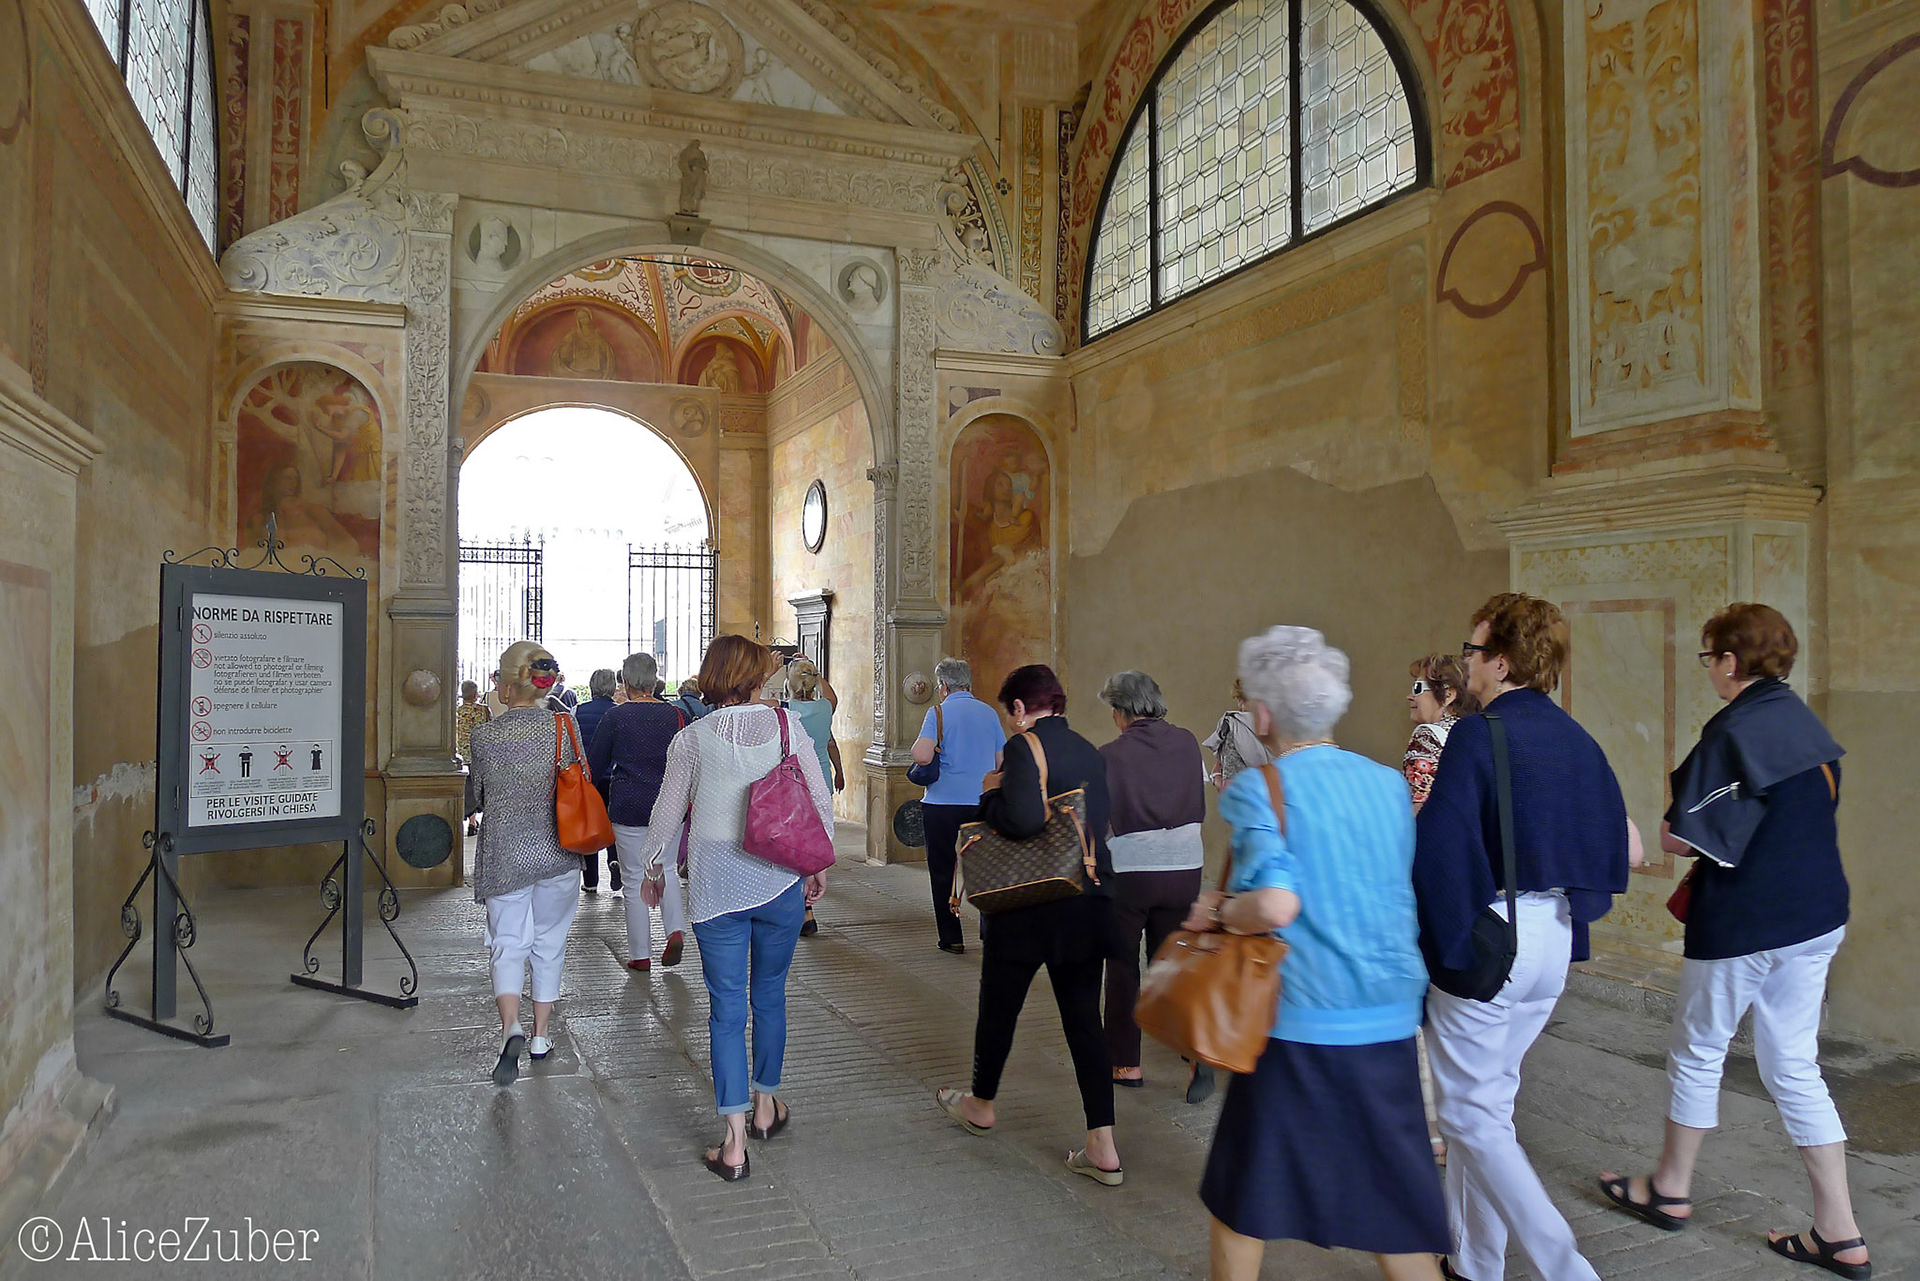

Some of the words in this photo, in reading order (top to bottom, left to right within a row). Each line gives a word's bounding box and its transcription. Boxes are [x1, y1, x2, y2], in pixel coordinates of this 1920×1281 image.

[192, 607, 238, 621] NORME
[242, 609, 260, 622] DA
[264, 610, 332, 626] RISPETTARE
[214, 631, 238, 639] silenzio
[240, 654, 276, 664] fotografare
[283, 655, 304, 663] filmare
[304, 664, 324, 672] filming
[214, 670, 258, 679] fotografieren
[234, 678, 254, 687] puede
[280, 686, 323, 695] photographier
[213, 702, 244, 711] spegnere
[228, 727, 262, 735] introdurre
[263, 726, 292, 734] biciclette
[206, 798, 226, 808] PER
[228, 797, 240, 807] LE
[243, 795, 275, 806] VISITE
[278, 792, 318, 804] GUIDATE
[207, 806, 266, 820] RIVOLGERSI
[269, 806, 280, 816] IN
[282, 803, 317, 814] CHIESA
